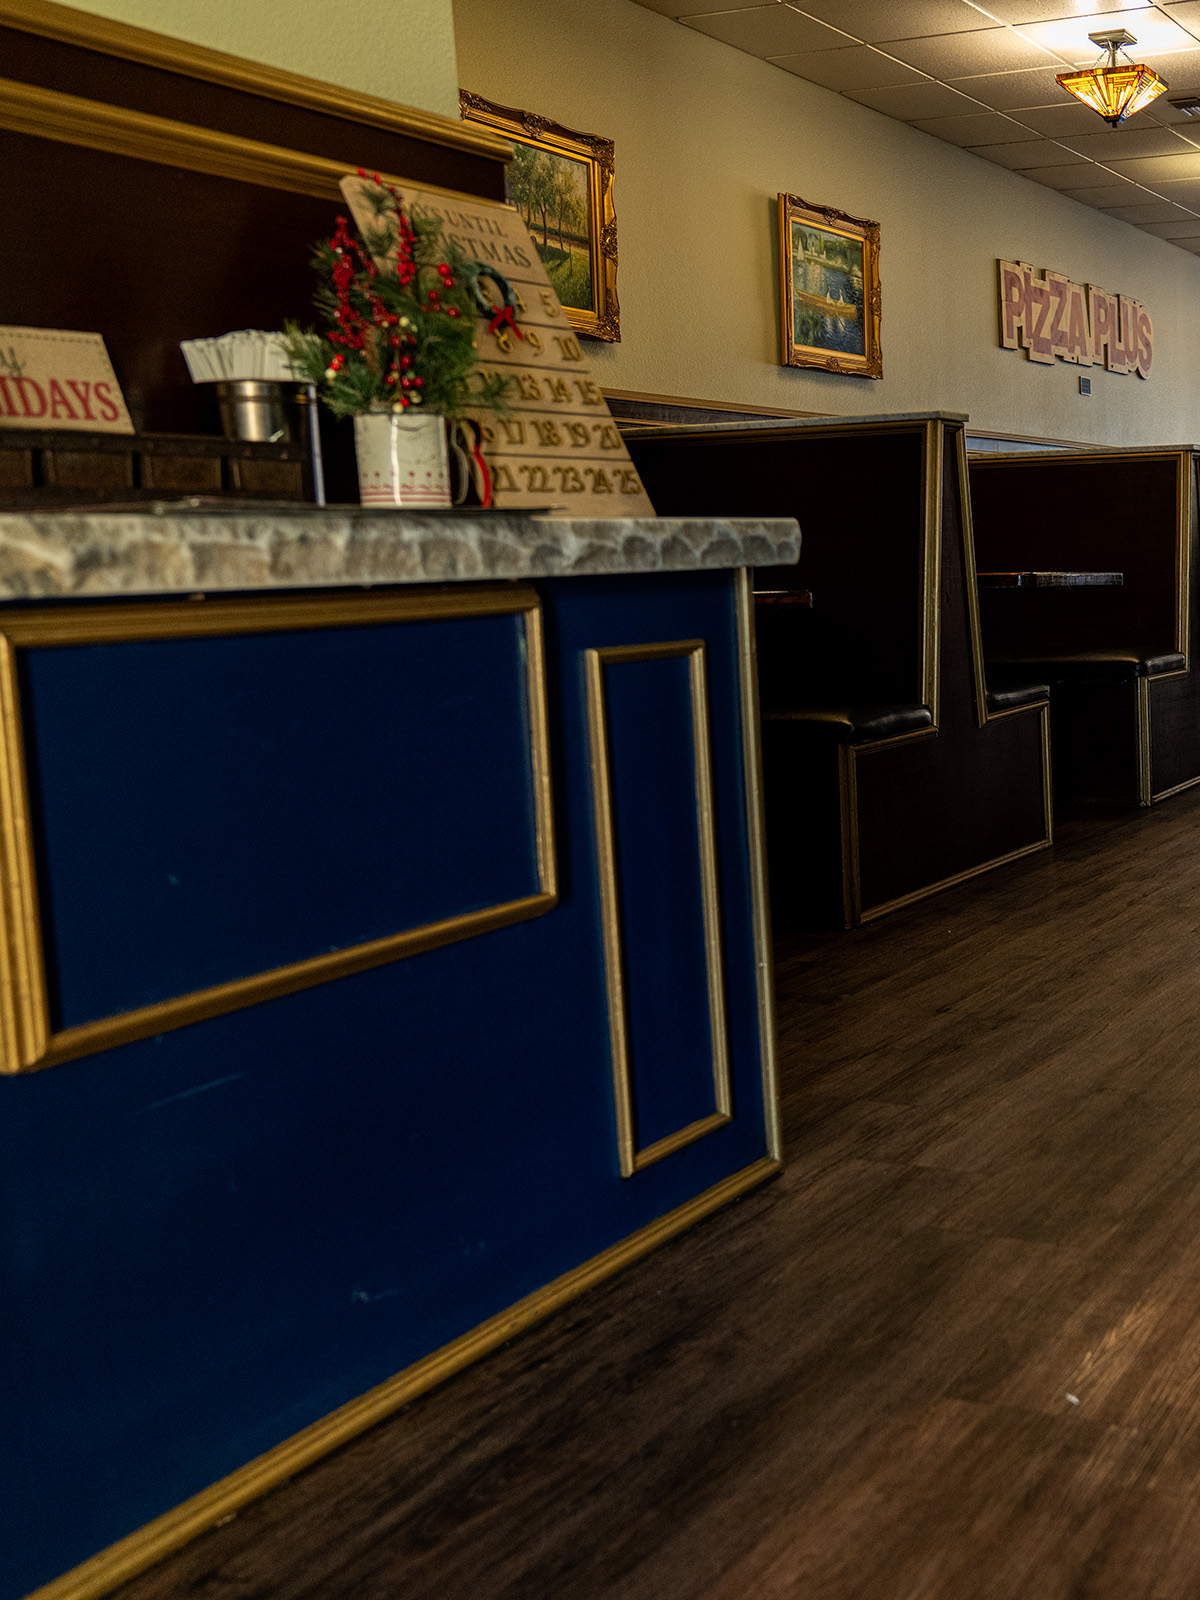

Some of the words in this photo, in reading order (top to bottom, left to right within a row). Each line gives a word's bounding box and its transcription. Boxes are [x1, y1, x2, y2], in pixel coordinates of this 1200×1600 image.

[444, 209, 509, 239] UNTIL
[1003, 269, 1088, 357] PIZZA
[1094, 292, 1153, 373] PLUS
[525, 330, 546, 358] 9
[554, 335, 585, 362] 10
[0, 375, 120, 423] IDAYS
[544, 376, 573, 403] 14
[573, 379, 601, 406] 15
[499, 418, 526, 445] 17
[530, 420, 563, 447] 18
[562, 421, 592, 448] 19
[592, 423, 622, 450] 20
[519, 464, 556, 493] 22
[552, 465, 587, 494] 23
[584, 467, 615, 495] 24
[613, 468, 643, 496] 25
